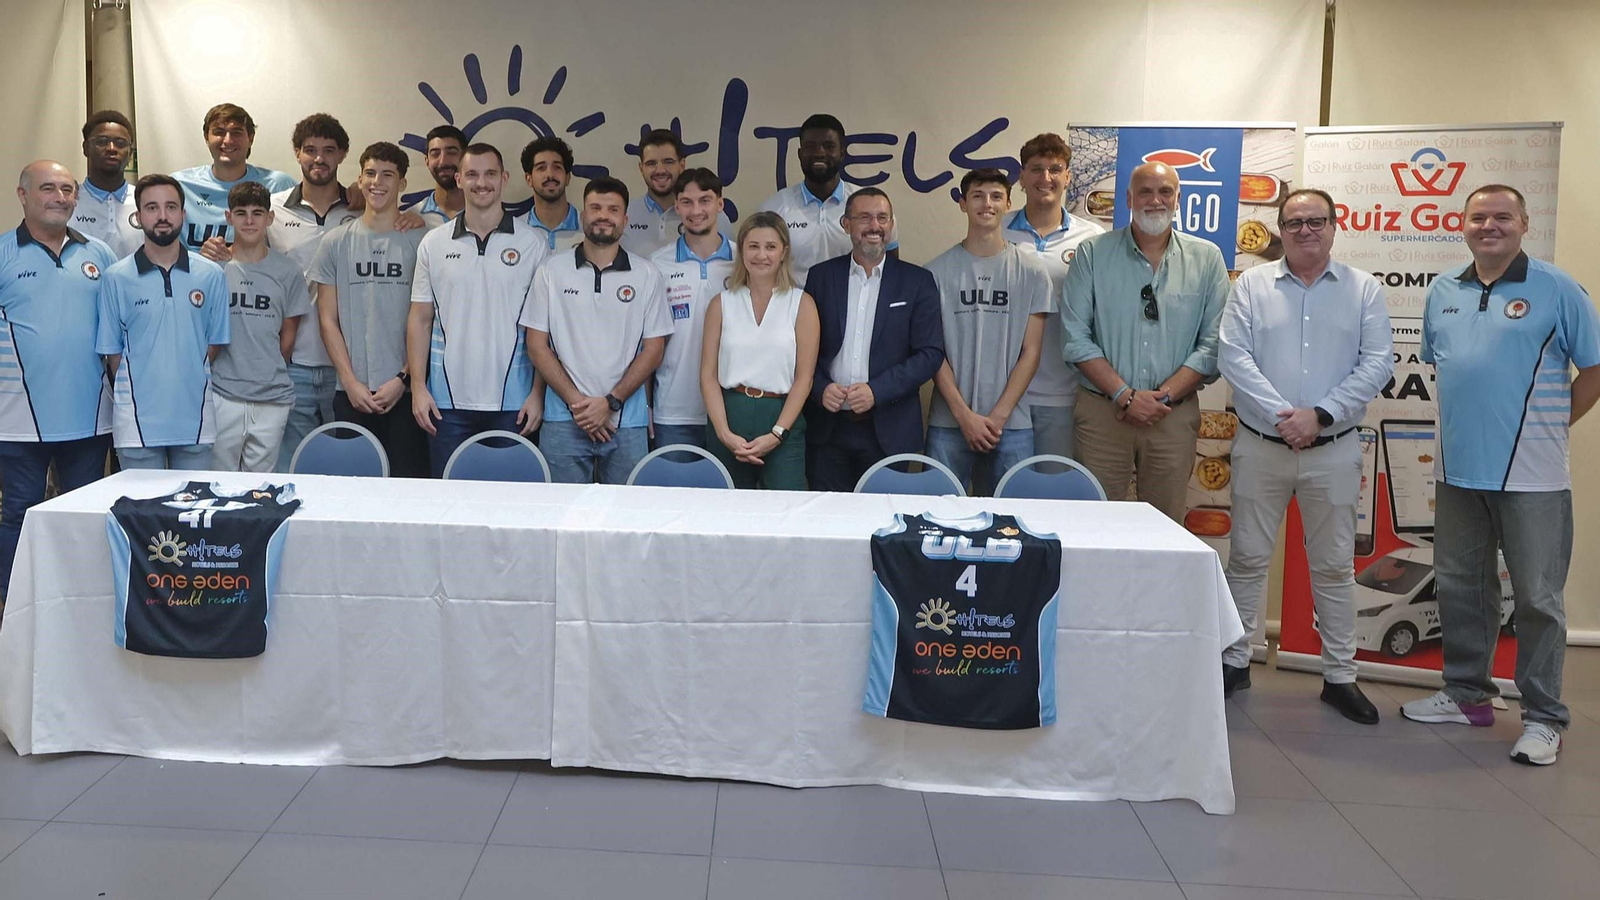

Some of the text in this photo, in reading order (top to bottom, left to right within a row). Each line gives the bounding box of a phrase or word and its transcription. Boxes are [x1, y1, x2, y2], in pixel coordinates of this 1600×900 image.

[787, 221, 808, 229] vive
[1334, 203, 1402, 232] Ruiz
[187, 223, 234, 247] UL
[1380, 235, 1467, 243] SUPERMERCADO
[356, 261, 403, 278] ULB
[960, 289, 1009, 306] ULB
[955, 564, 978, 598] 4
[167, 590, 204, 607] build
[207, 590, 247, 605] resorts
[935, 659, 972, 676] build
[976, 660, 1019, 675] resorts
